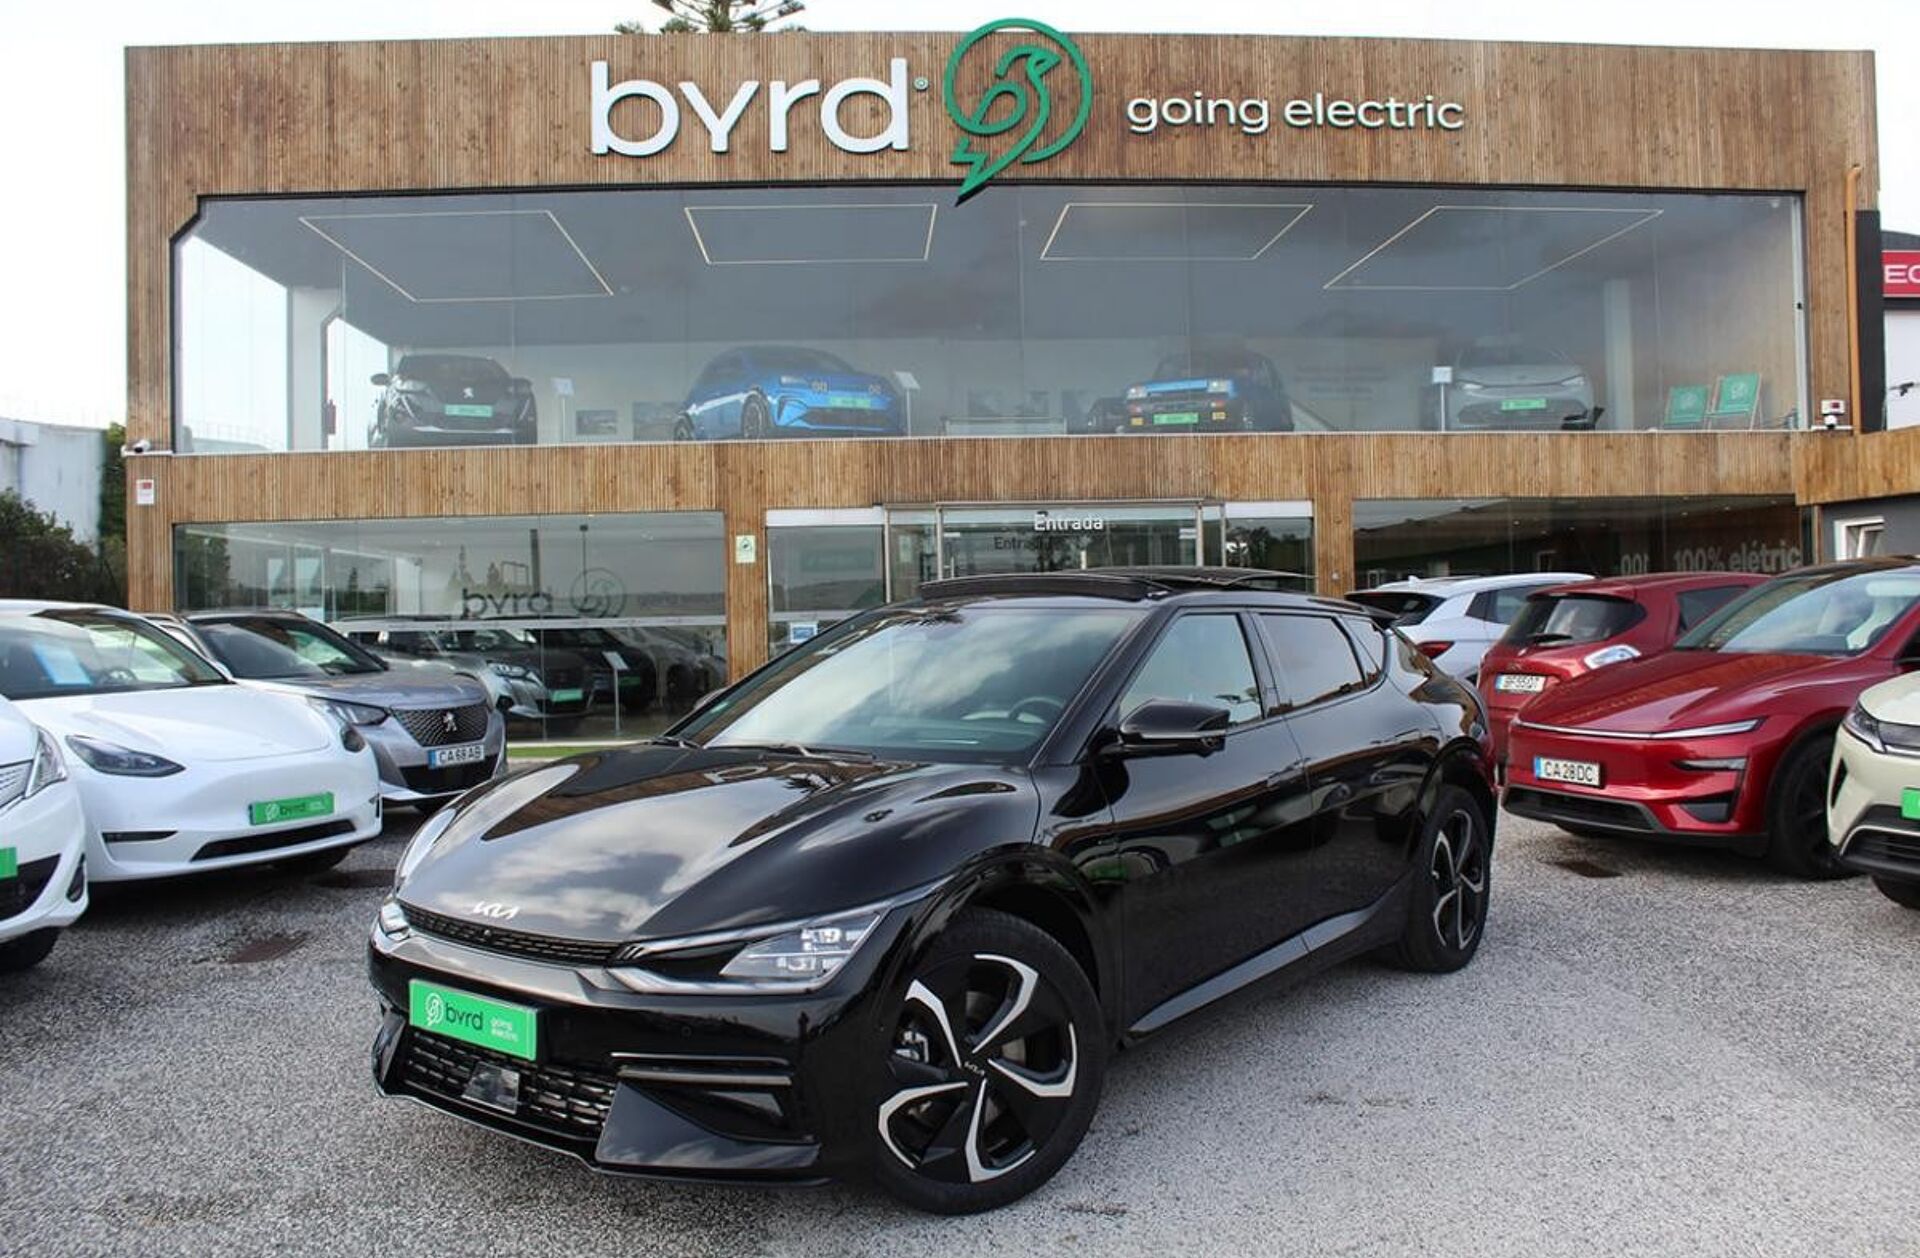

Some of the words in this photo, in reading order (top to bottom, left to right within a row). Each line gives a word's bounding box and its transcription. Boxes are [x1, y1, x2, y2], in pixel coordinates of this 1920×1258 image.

[591, 57, 909, 157] byrd
[1127, 91, 1270, 134] going
[1284, 93, 1464, 129] electric
[1034, 512, 1104, 531] Entrada
[1673, 546, 1725, 573] 100%
[445, 1002, 484, 1031] byrd
